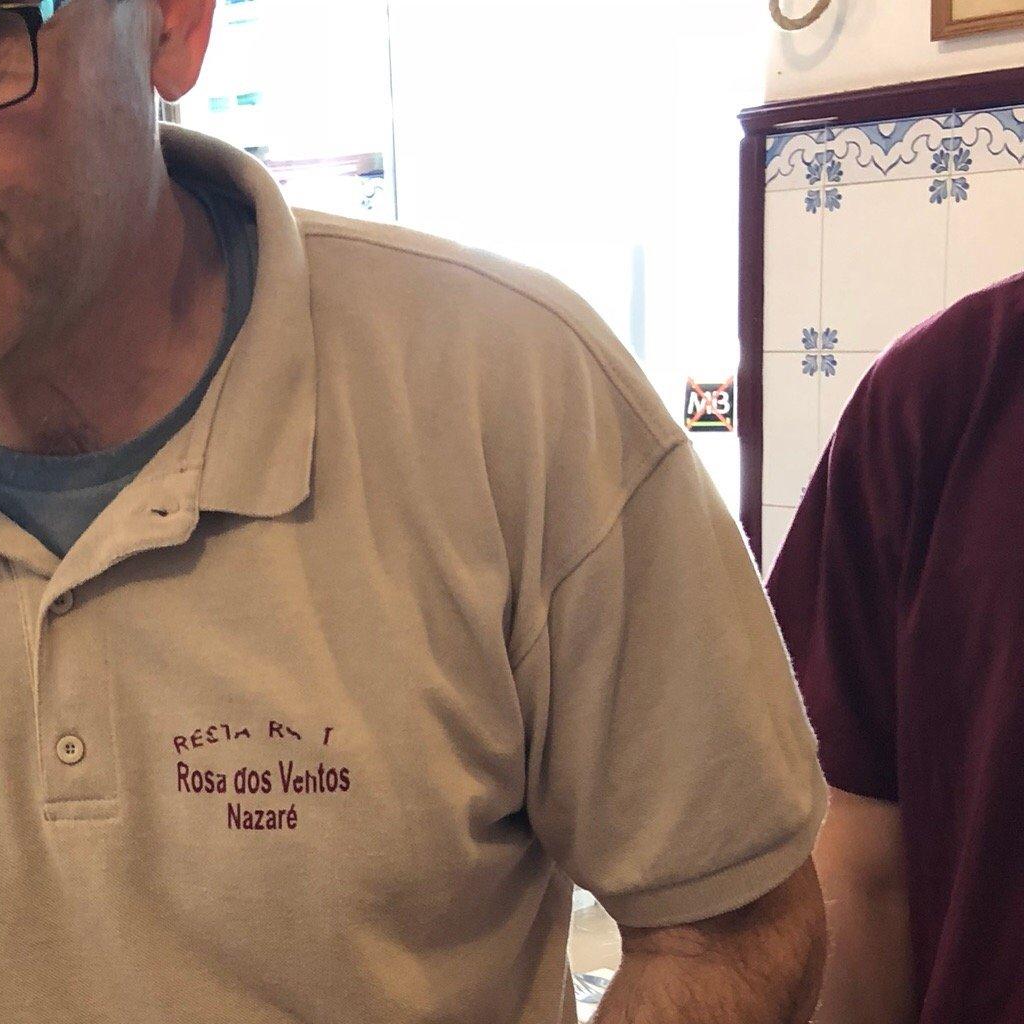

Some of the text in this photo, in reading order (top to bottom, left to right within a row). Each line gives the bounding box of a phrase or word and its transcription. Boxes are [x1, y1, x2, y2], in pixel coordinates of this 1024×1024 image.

[177, 760, 351, 794] Rosa dos Ventos
[227, 802, 298, 831] Nazaré
